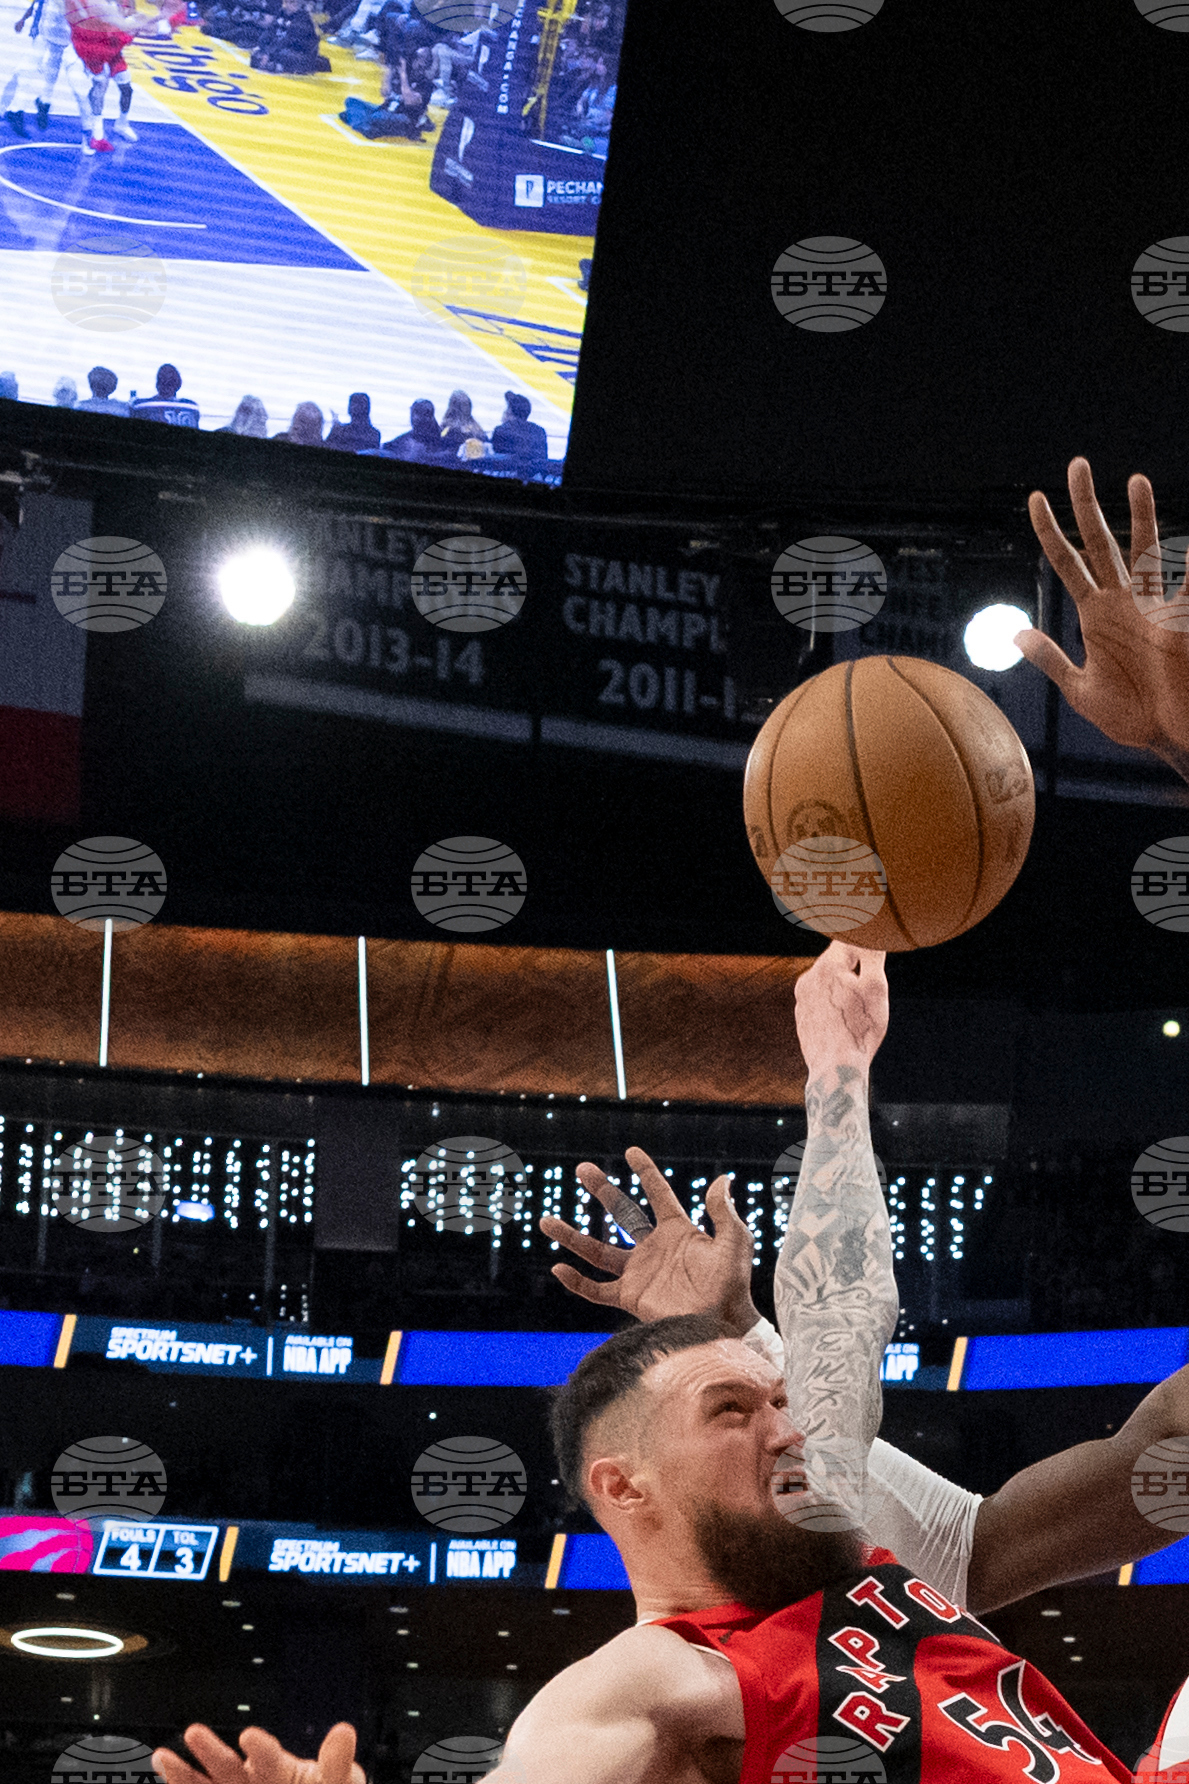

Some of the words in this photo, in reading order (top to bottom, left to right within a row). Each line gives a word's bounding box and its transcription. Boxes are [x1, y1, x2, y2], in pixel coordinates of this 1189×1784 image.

[564, 552, 721, 607] STANLEY
[562, 595, 727, 653] CHAMPI
[302, 612, 487, 686] 2013-14
[597, 657, 737, 719] 2011-1
[106, 1338, 258, 1365] SPORTSNET+
[283, 1345, 318, 1373] NBA
[318, 1347, 352, 1374] APP
[111, 1528, 157, 1543] FOULS
[119, 1543, 142, 1571] 4
[173, 1547, 195, 1575] 3
[268, 1550, 421, 1574] SPORTSNET+
[447, 1551, 481, 1578] NBA
[482, 1551, 517, 1578] APP
[829, 1575, 963, 1753] RAPTO
